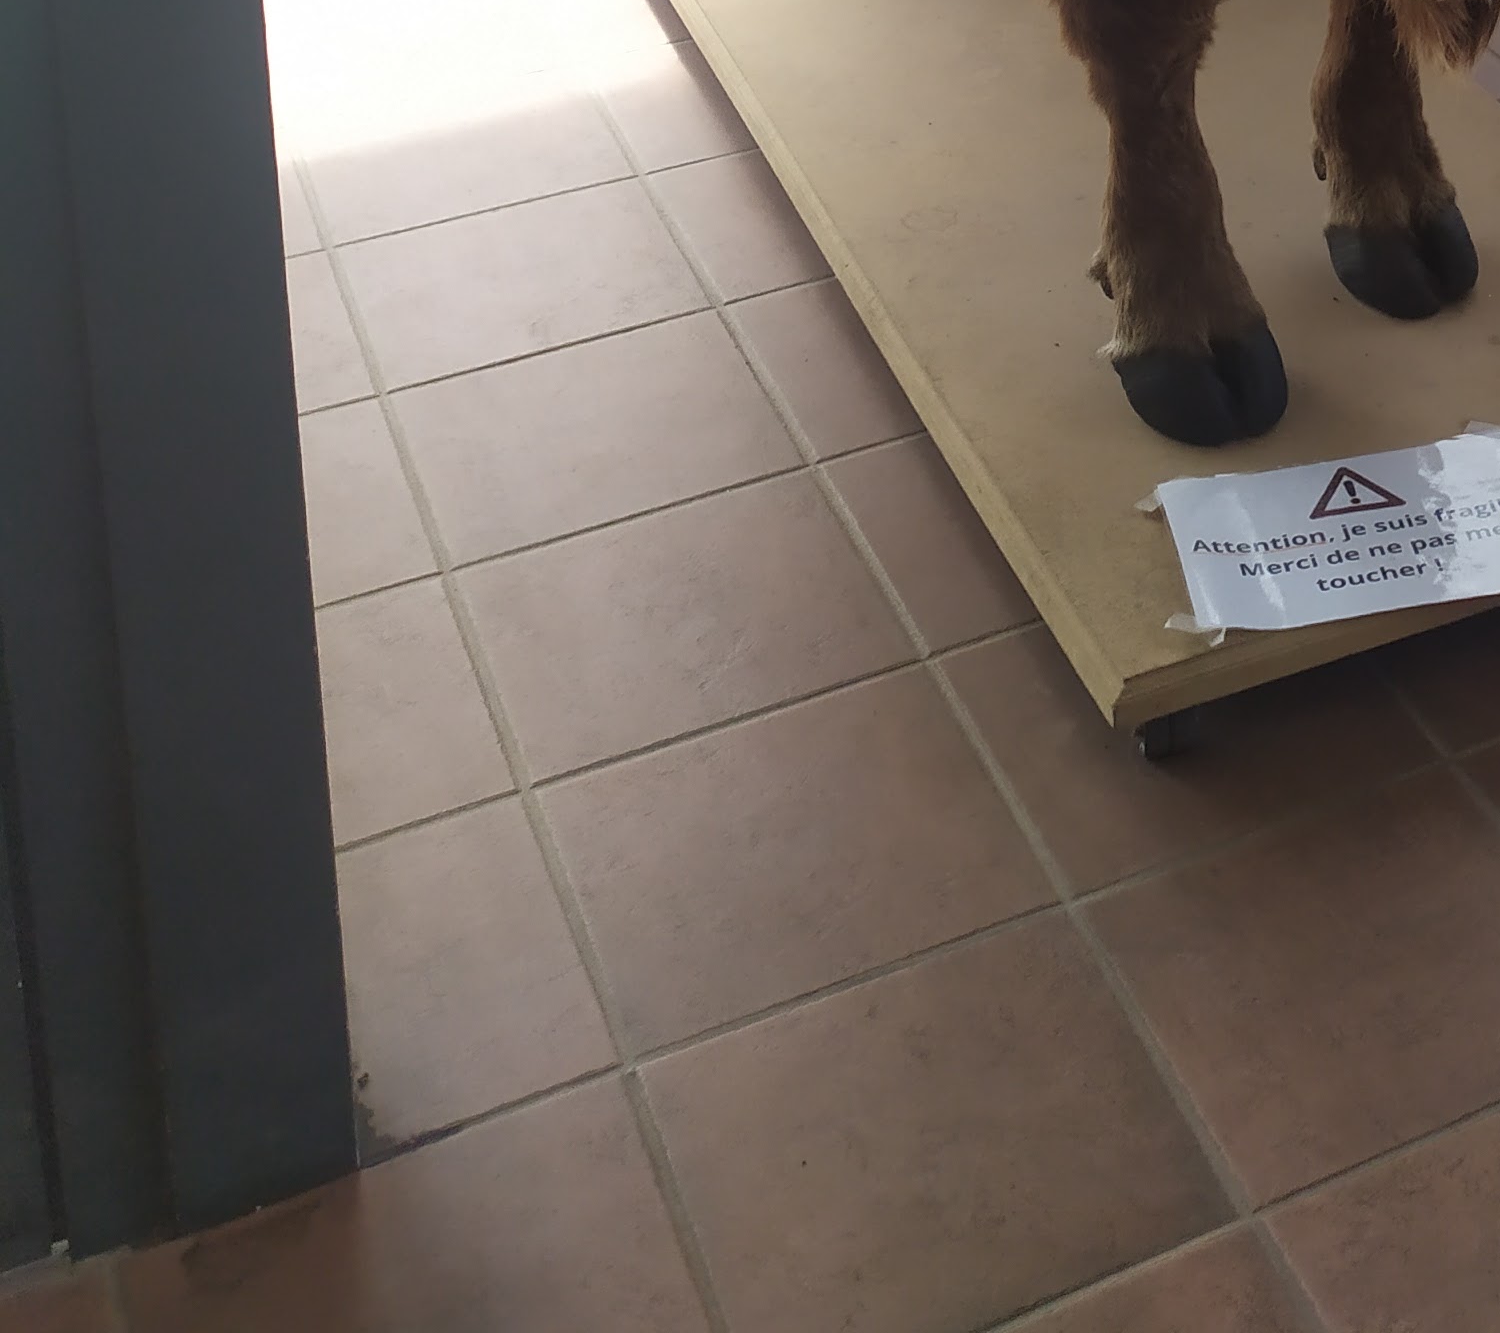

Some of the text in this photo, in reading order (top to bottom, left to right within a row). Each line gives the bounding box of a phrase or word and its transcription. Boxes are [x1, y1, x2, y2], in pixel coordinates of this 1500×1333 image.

[1192, 526, 1335, 556] Attention,
[1341, 521, 1367, 543] je
[1374, 511, 1429, 534] suis
[1240, 553, 1319, 579] Merci
[1326, 543, 1360, 566] de
[1369, 542, 1403, 559] ne
[1410, 530, 1458, 556] pas
[1316, 559, 1429, 593] toucher
